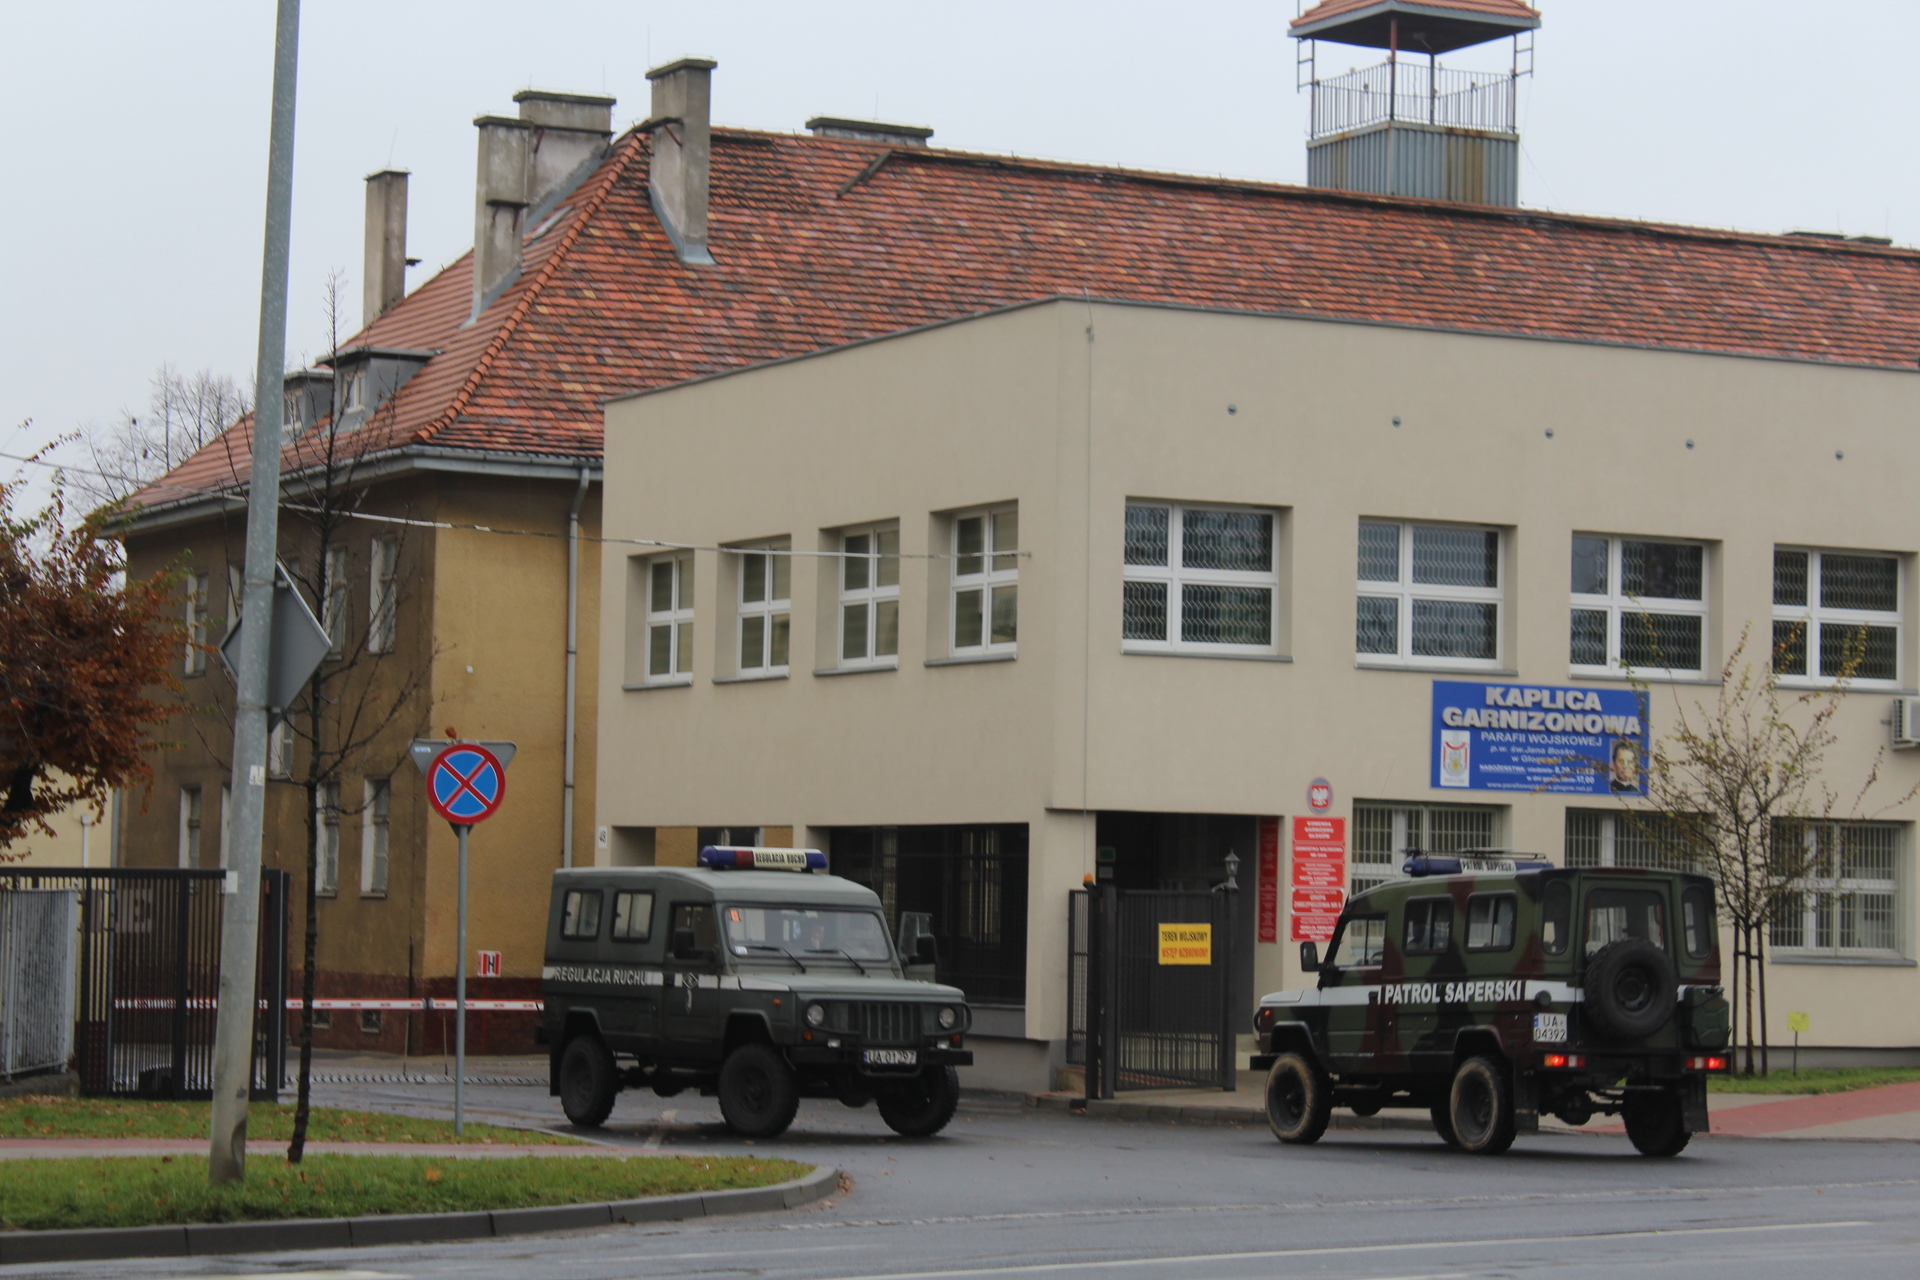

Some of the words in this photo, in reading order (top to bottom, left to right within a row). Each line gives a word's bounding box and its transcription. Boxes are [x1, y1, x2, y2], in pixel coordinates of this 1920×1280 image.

[1485, 686, 1602, 711] KAPLICA
[1442, 706, 1642, 735] GARNIZONOWA
[1480, 731, 1525, 743] PARAFII
[1528, 733, 1603, 747] WOJSKOWEJ
[755, 852, 785, 863] REGULACJA
[786, 853, 805, 865] RUCHU
[1462, 860, 1483, 871] PATROL
[1162, 931, 1178, 942] TEREN
[1179, 931, 1208, 942] WOJSKOWY
[554, 966, 611, 984] REGULACJA
[613, 969, 648, 986] RUCHU
[1385, 983, 1441, 1004] PATROL
[1444, 980, 1522, 1003] SAPERSKI
[1543, 1014, 1558, 1027] UA
[1535, 1028, 1566, 1042] 04392
